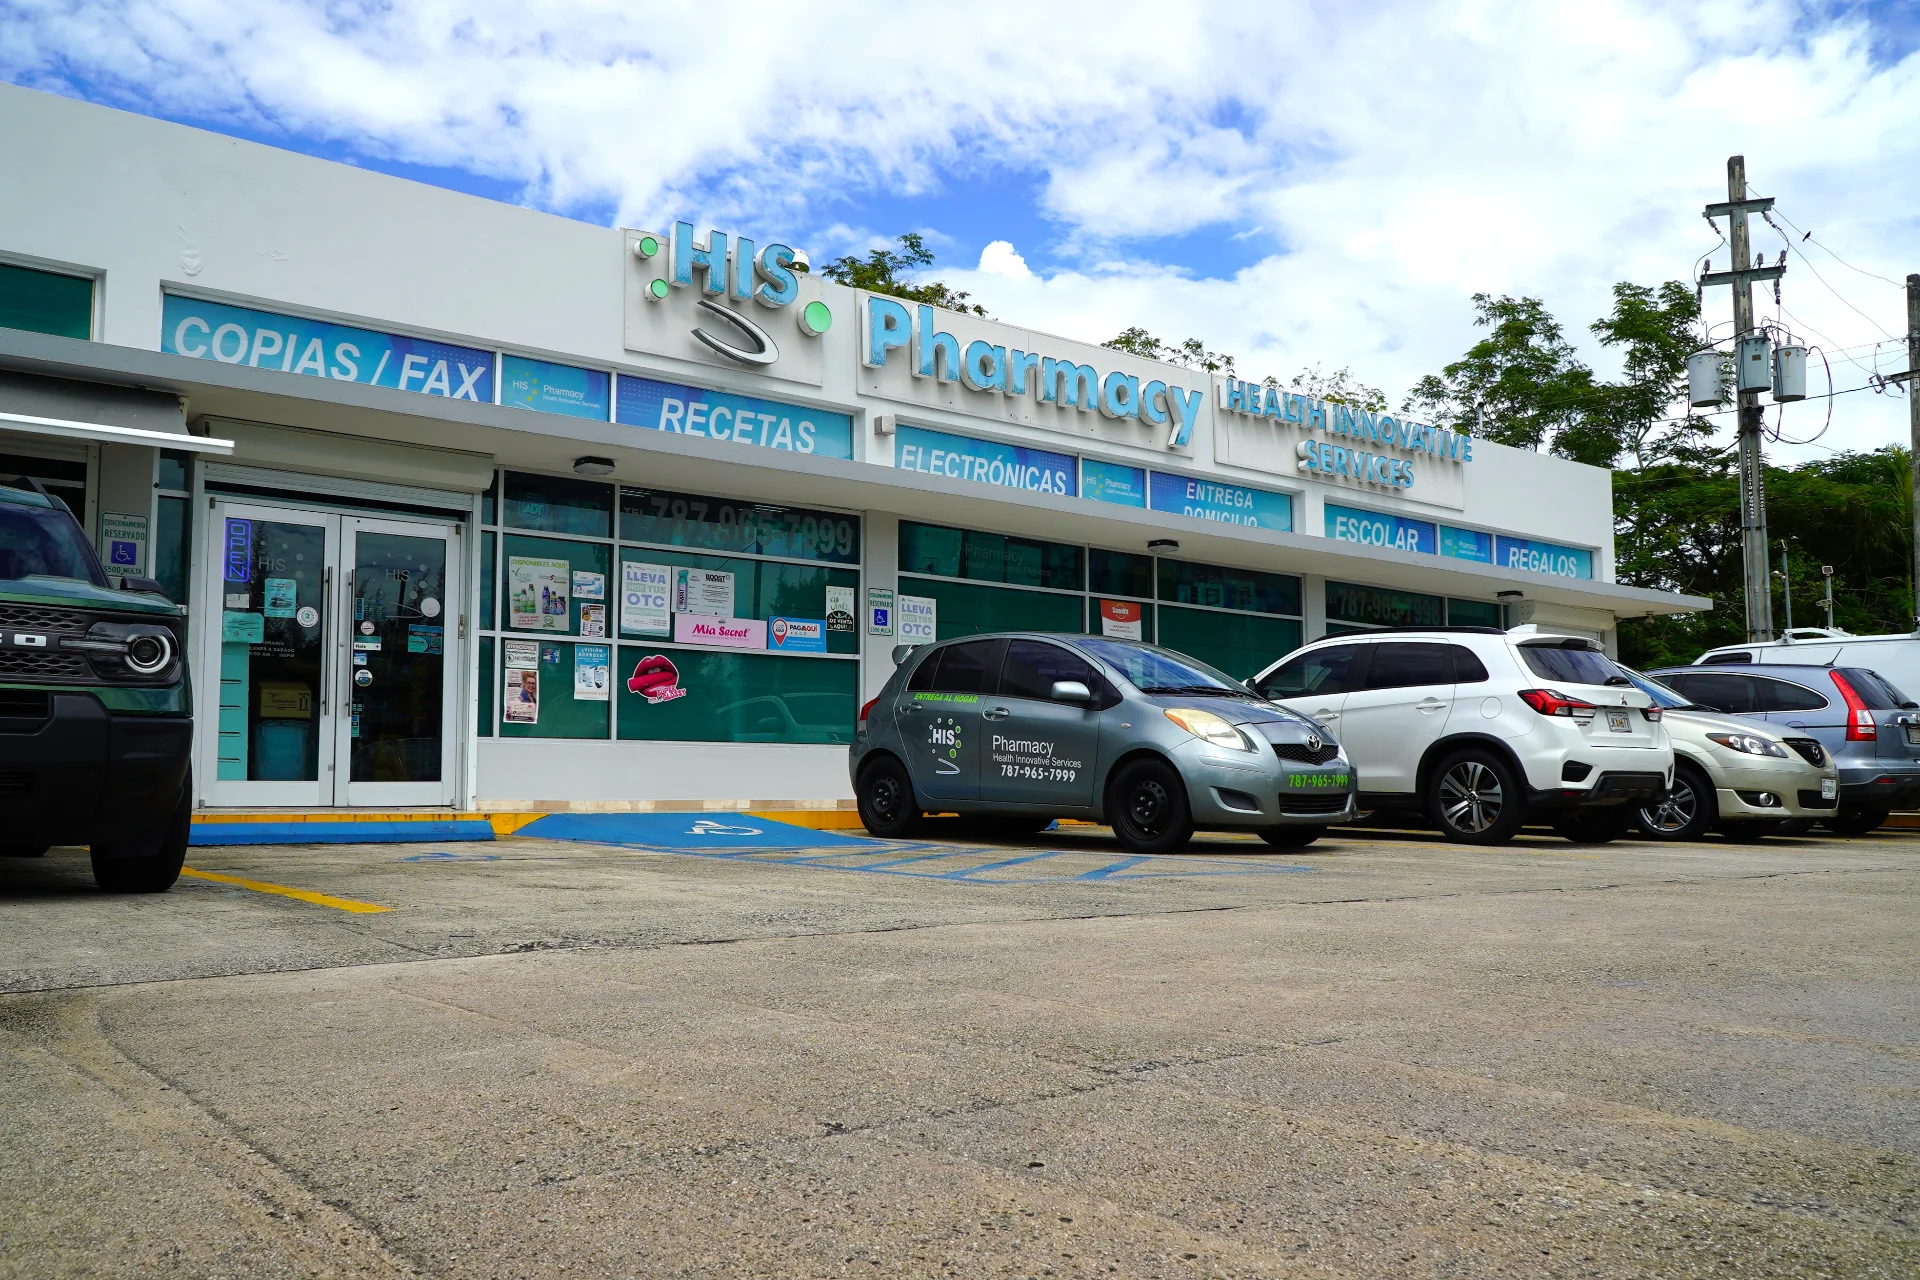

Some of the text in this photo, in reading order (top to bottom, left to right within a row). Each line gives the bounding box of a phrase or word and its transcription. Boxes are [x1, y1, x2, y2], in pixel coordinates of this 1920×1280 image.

[669, 220, 798, 308] HIS
[174, 316, 360, 381] COPIAS
[398, 354, 486, 402] FAX
[861, 295, 1203, 449] Pharmacy
[512, 380, 528, 390] HIS
[543, 384, 584, 400] Pharmacy
[659, 398, 816, 455] RECETAS
[1221, 378, 1472, 463] HEALTH INNOVATIVE
[901, 444, 1067, 496] ELECTRÓNICAS
[1297, 439, 1414, 489] SERVICES
[1086, 475, 1097, 485] HIS
[1105, 478, 1131, 491] Pharmacy
[1186, 482, 1253, 509] ENTREGA
[525, 503, 544, 515] ADT
[104, 519, 146, 529] ESTACIONAMIENTO
[650, 496, 852, 556] 787-965-7999
[104, 529, 145, 540] RESERVADO
[1336, 516, 1418, 552] ESCOLAR
[229, 523, 246, 578] OPEN
[965, 543, 1024, 565] Pharmacy
[258, 557, 286, 572] HIS
[1508, 546, 1577, 578] REGALOS
[123, 567, 142, 575] MULTA
[385, 568, 411, 582] HIS
[626, 571, 666, 584] LLEVA
[628, 583, 666, 594] HOY TUS
[626, 593, 665, 608] OTC
[901, 603, 933, 615] LLEVA
[692, 623, 716, 635] Mia
[718, 626, 749, 638] Secret
[902, 622, 932, 636] OTC
[914, 692, 979, 704] ENTREGA AL HOGAR
[932, 729, 955, 745] HIS
[992, 735, 1054, 758] Pharmacy
[992, 753, 1082, 769] Health Innovative Services
[1001, 764, 1076, 783] 787-965-7999
[1289, 774, 1349, 788] 787-965-7999
